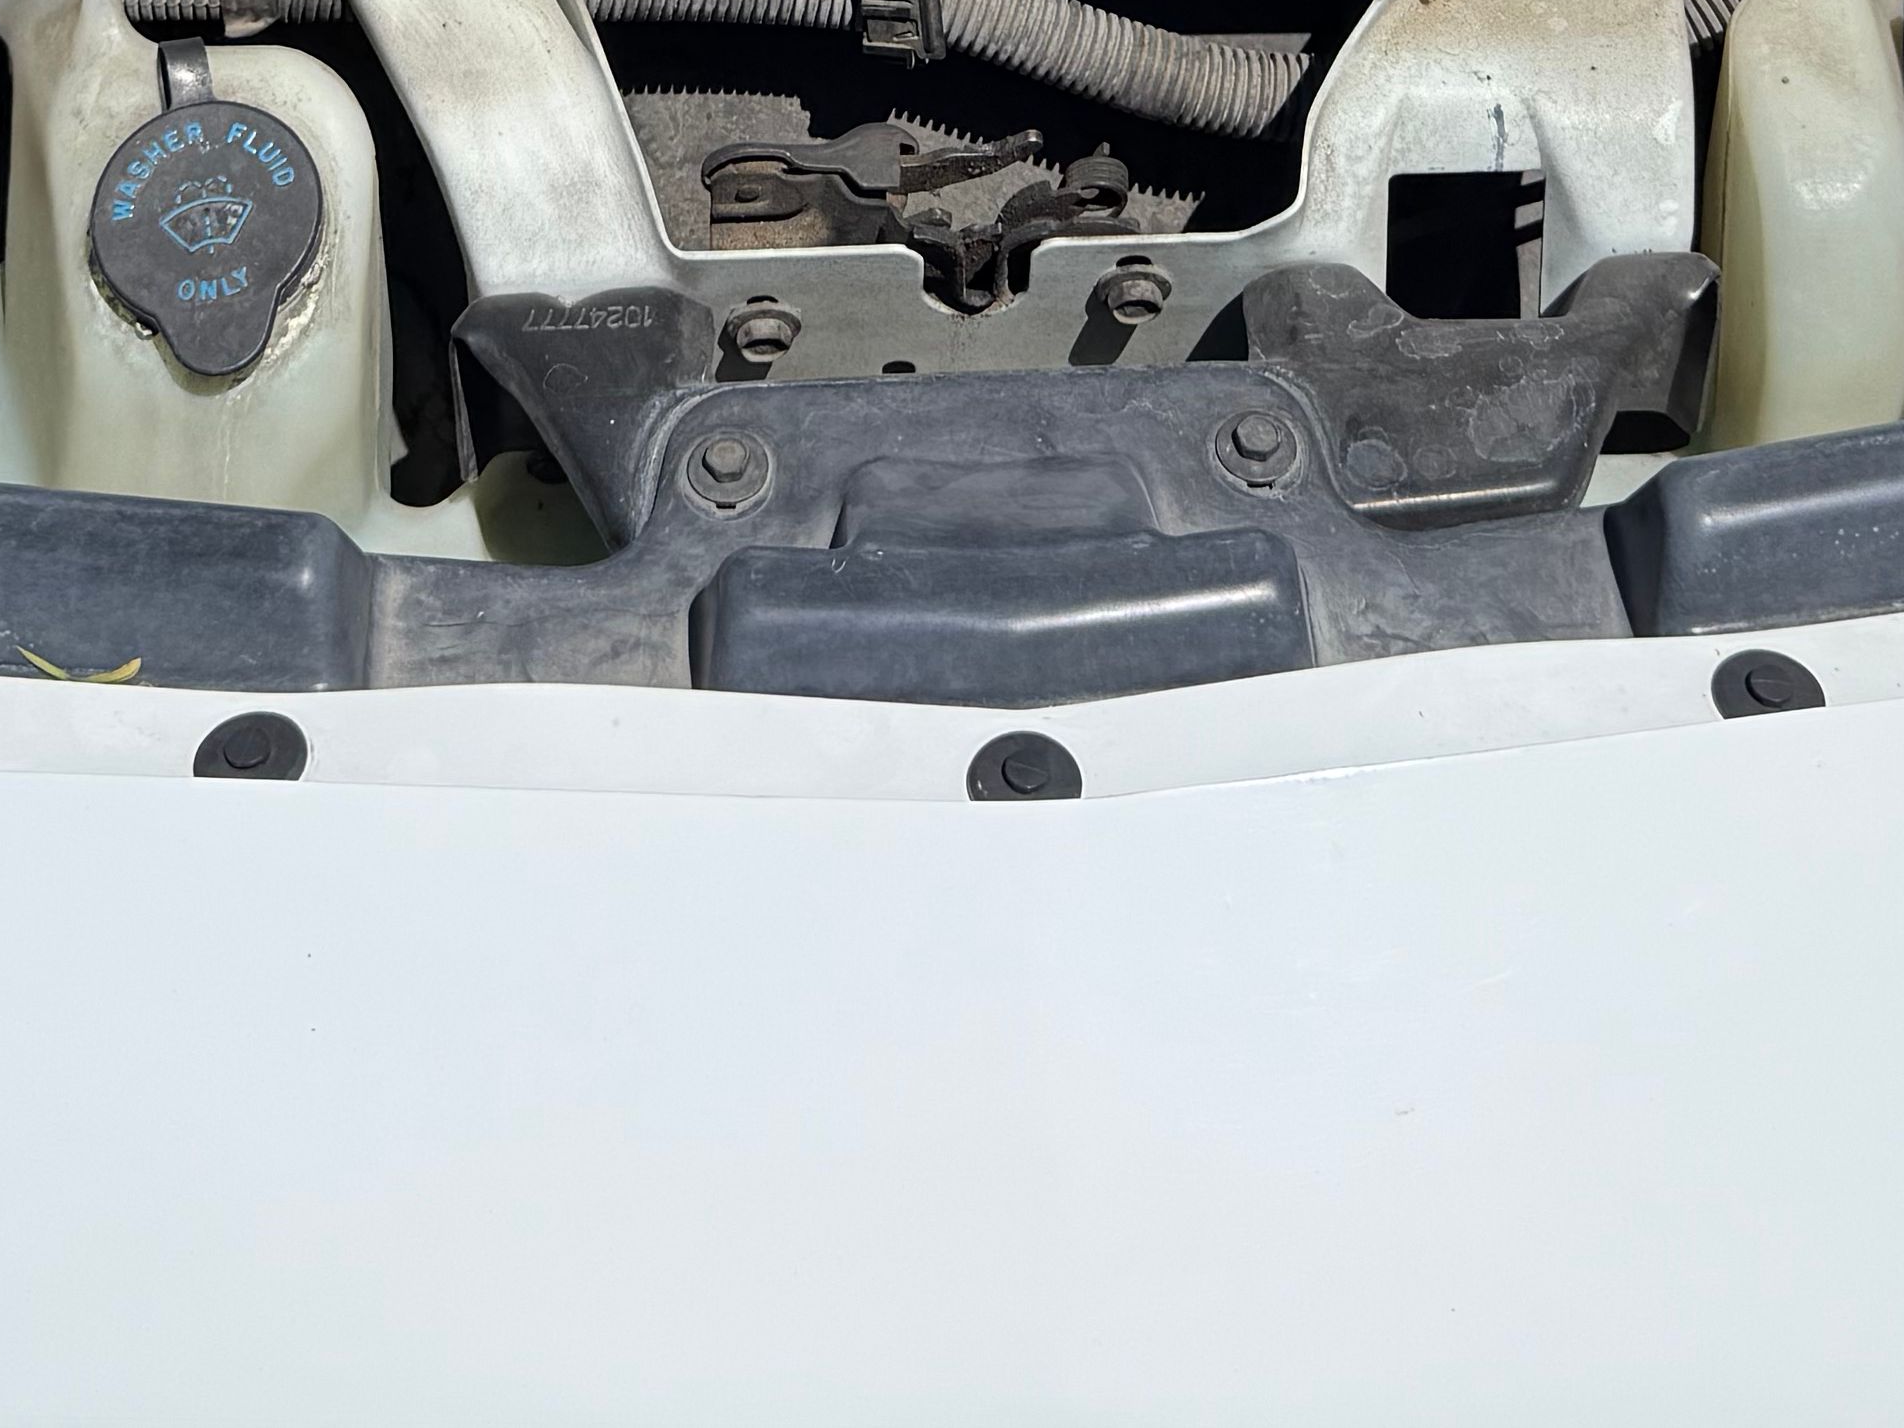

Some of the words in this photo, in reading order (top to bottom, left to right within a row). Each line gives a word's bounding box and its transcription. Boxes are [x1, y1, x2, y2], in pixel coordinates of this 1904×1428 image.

[111, 120, 204, 221] WASHER
[225, 122, 295, 187] FLUID
[177, 266, 248, 301] ONLY
[521, 305, 654, 332] 10247777
